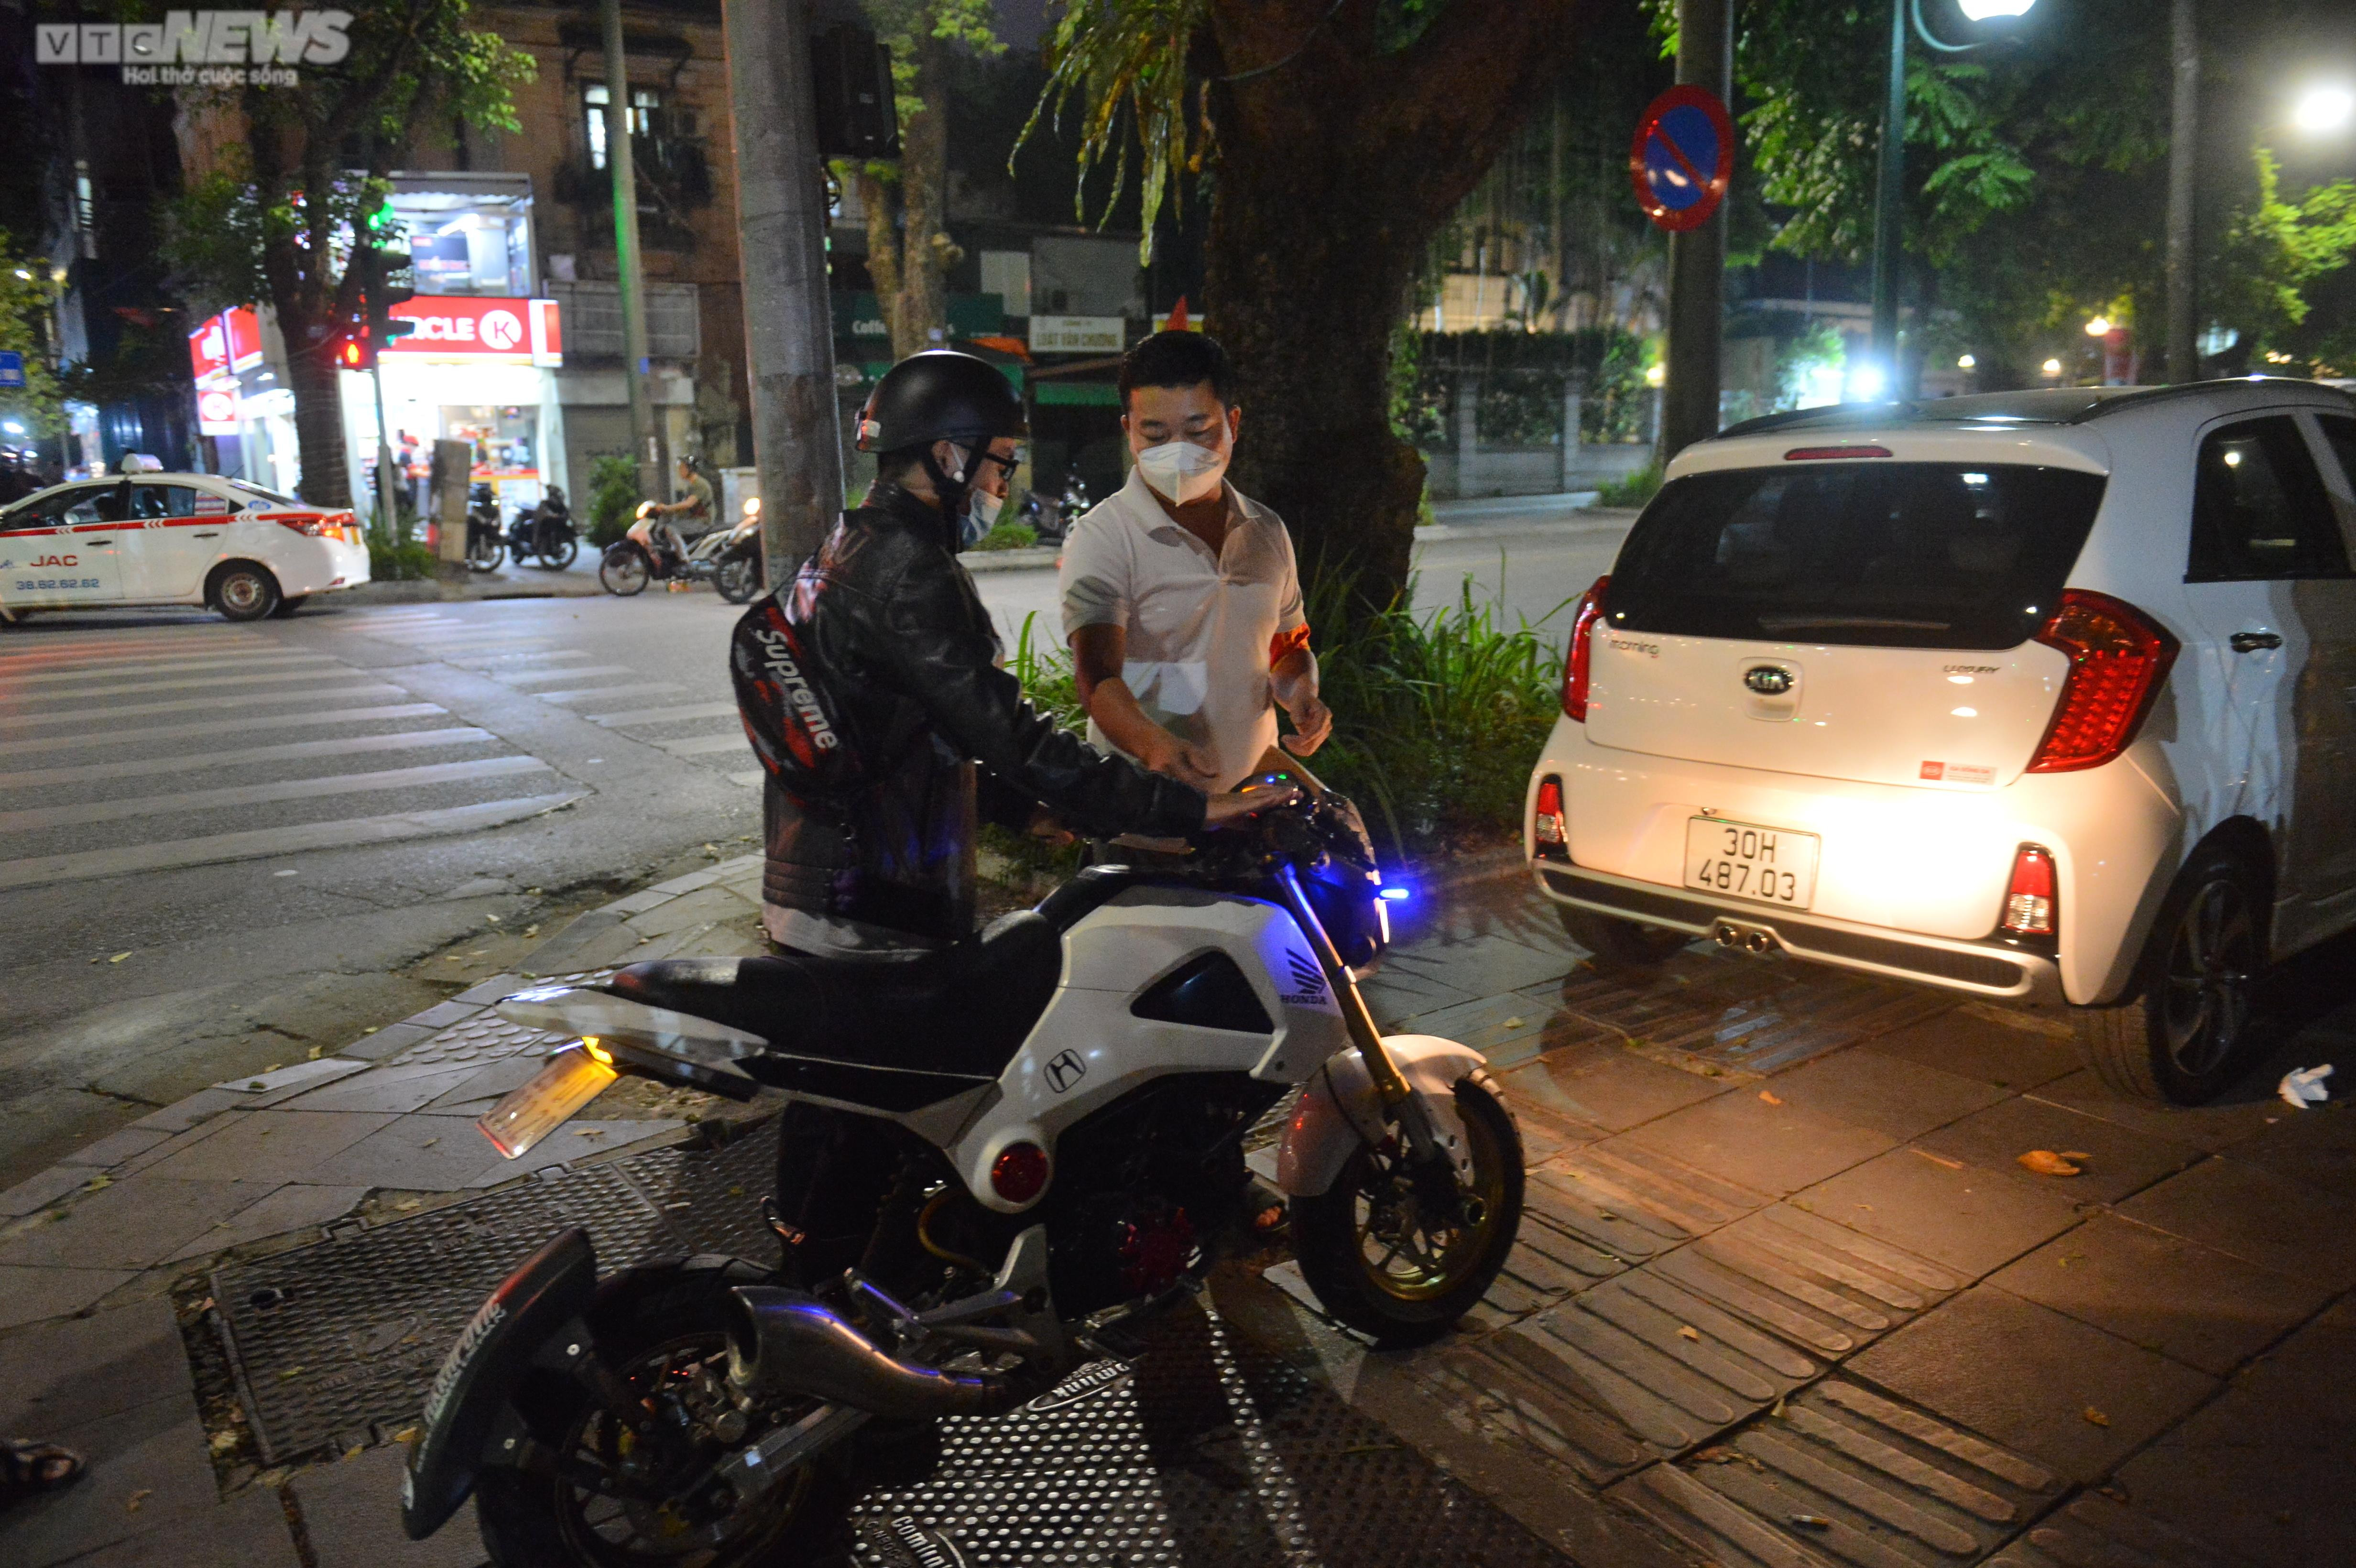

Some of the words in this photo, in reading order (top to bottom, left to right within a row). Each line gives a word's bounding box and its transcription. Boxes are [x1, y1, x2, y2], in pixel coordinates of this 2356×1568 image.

[389, 316, 476, 340] RCLE
[30, 554, 78, 567] JAC
[754, 629, 839, 749] Supreme
[1748, 671, 1786, 689] KIA
[1723, 827, 1777, 863] 30H
[1699, 859, 1796, 902] 487.03
[1280, 994, 1328, 1005] HONDA
[891, 1515, 953, 1568] Comlin
